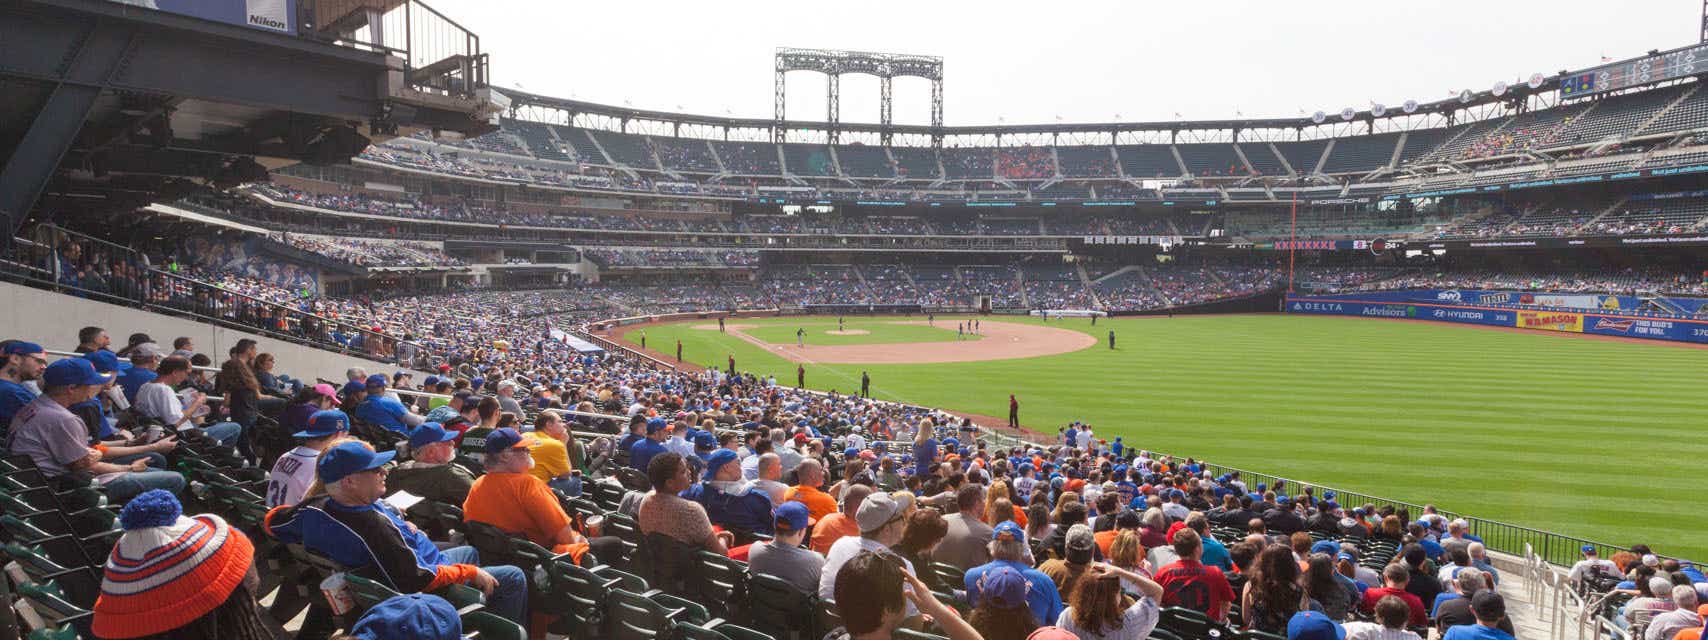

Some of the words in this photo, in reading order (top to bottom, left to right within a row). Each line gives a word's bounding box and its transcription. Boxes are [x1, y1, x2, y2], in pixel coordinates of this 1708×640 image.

[250, 15, 285, 29] Nikon
[1311, 197, 1370, 205] PORSCHE
[1437, 292, 1457, 300] SNY
[1305, 303, 1343, 311] DELTA
[1362, 306, 1406, 317] Advisors
[1447, 311, 1483, 320] HYUNDAI
[1652, 321, 1673, 329] BUD'S
